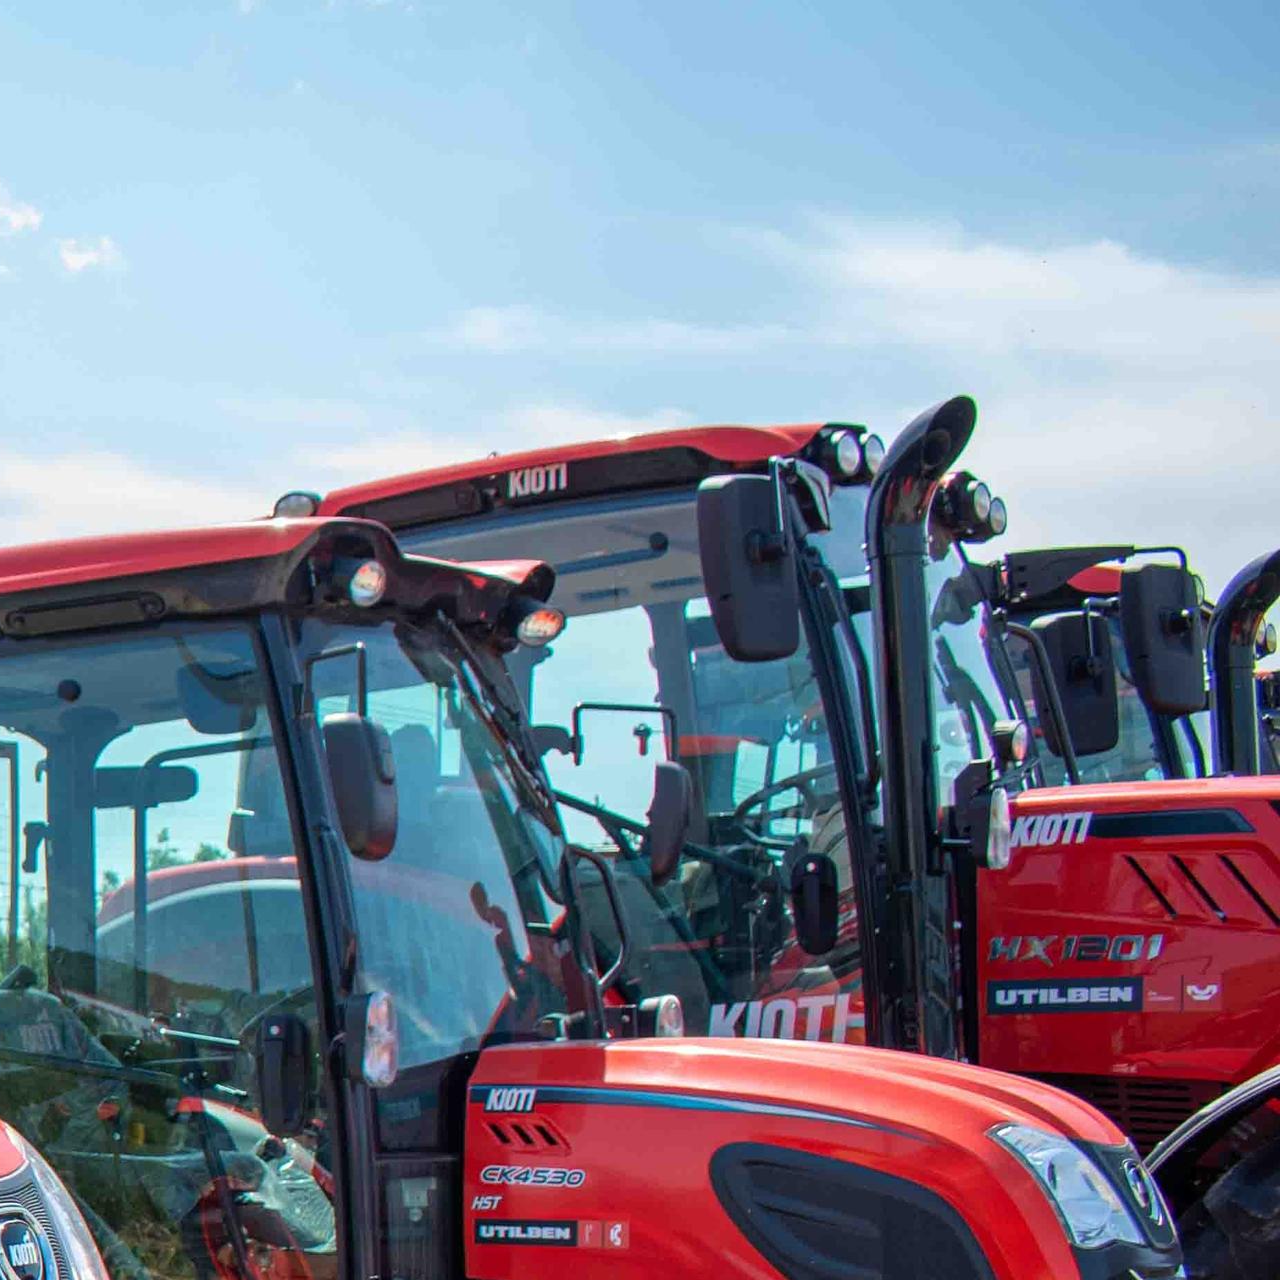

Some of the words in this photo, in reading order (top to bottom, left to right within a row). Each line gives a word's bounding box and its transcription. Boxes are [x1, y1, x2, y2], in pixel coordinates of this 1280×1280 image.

[509, 463, 567, 498] KIOTI
[1010, 812, 1094, 847] KIOTI
[995, 987, 1133, 1005] UTILBEN
[486, 1089, 536, 1111] KIOTI
[480, 1165, 586, 1188] CK4530
[472, 1196, 502, 1210] HST
[479, 1224, 571, 1240] UTILBEN
[9, 1242, 38, 1267] KIOTI
